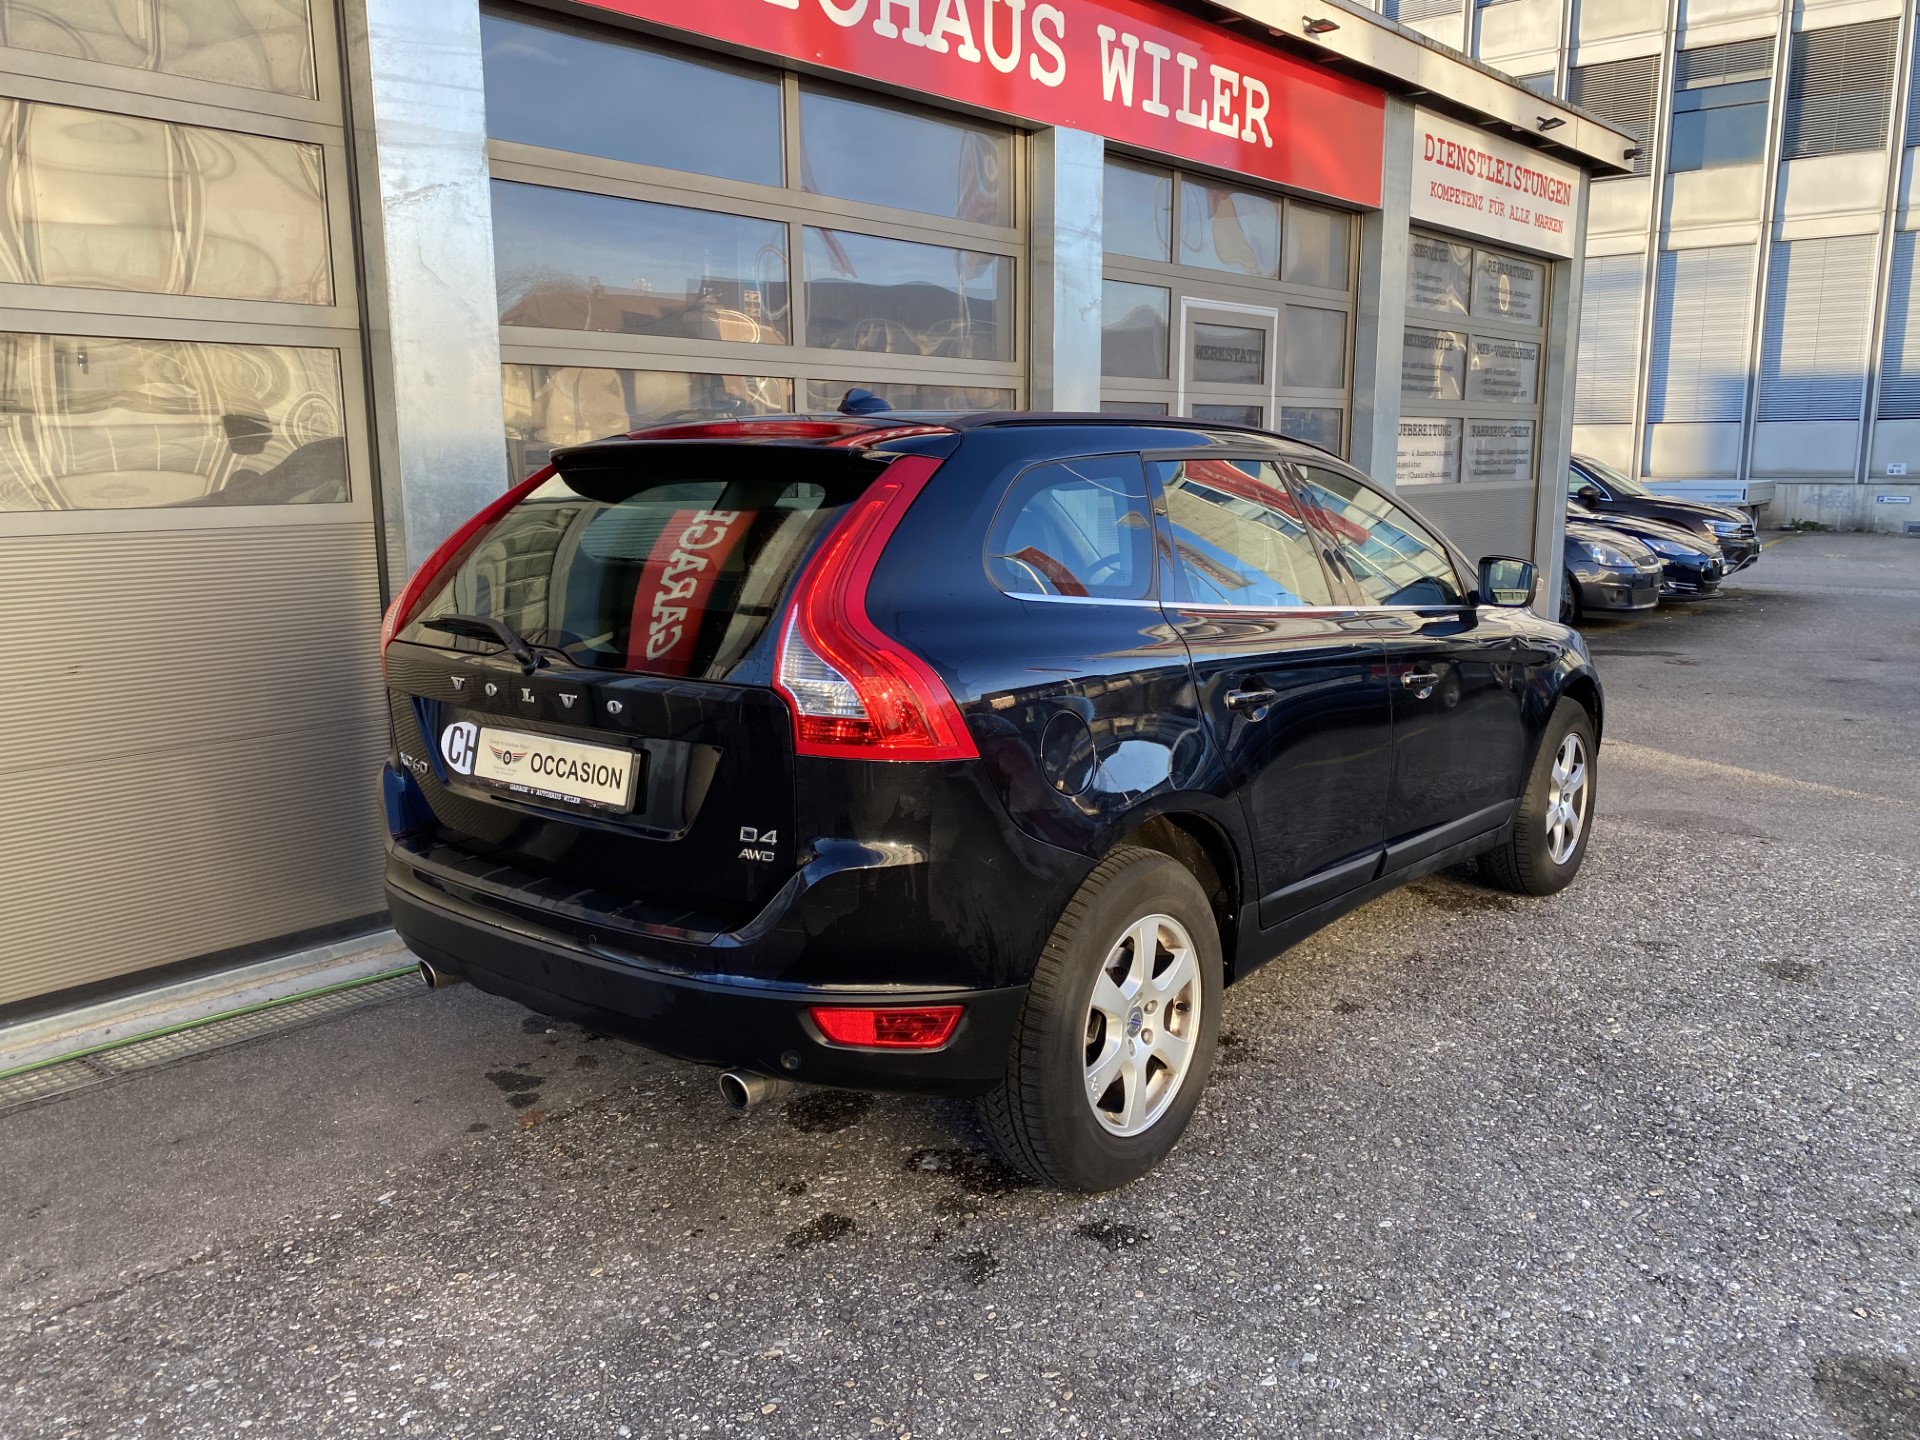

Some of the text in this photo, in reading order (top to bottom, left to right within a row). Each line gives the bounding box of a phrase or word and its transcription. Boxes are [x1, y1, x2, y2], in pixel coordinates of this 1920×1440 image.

[762, 0, 1274, 149] HAUS WILER
[1424, 133, 1572, 207] DIENSTLEISTUNGEN
[1430, 181, 1564, 234] KOMPETENZ FÜR ALLE MARKEN
[1487, 259, 1534, 281] REPARATUREN
[1404, 333, 1454, 351] NEUSERVICE
[1195, 344, 1261, 364] WERKSTATT
[1398, 423, 1452, 437] UFBEREITUNG
[450, 676, 624, 715] VOLVO
[448, 726, 476, 768] CH
[530, 752, 623, 790] OCCASION
[510, 784, 528, 793] GARAGE
[740, 826, 778, 846] D4
[737, 848, 775, 862] AWD
